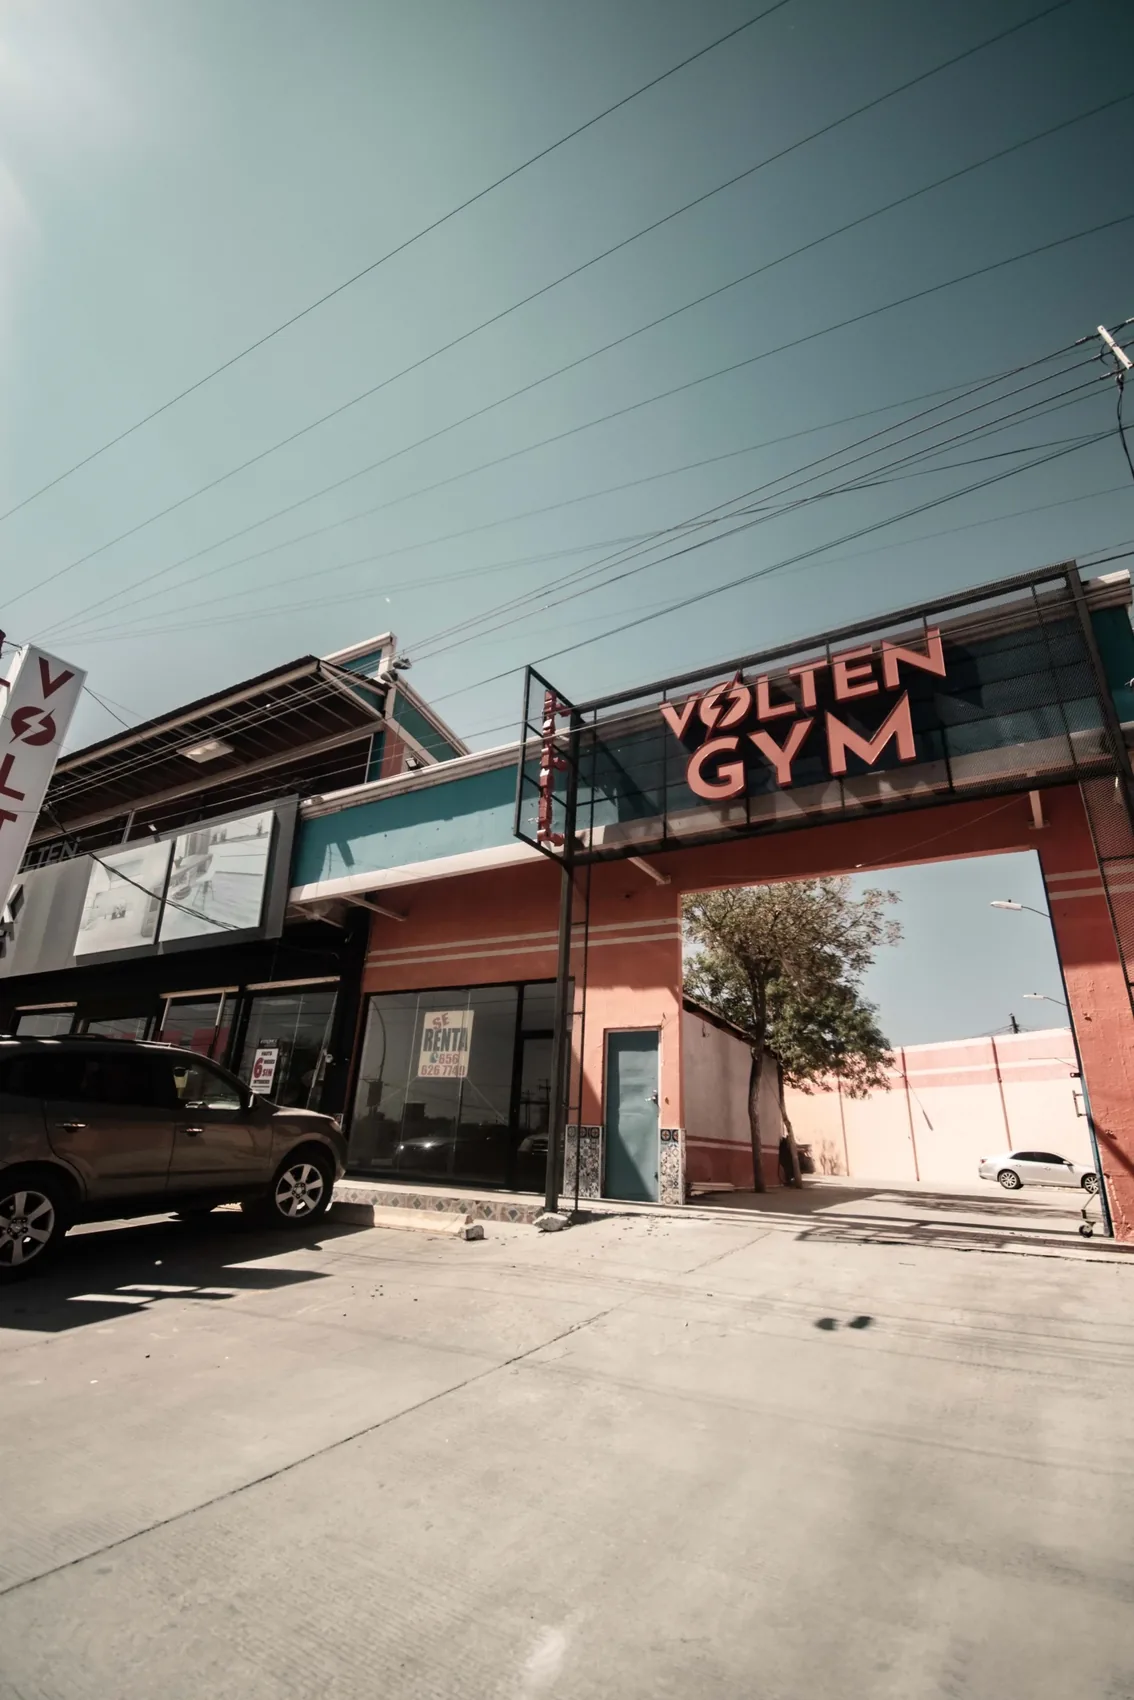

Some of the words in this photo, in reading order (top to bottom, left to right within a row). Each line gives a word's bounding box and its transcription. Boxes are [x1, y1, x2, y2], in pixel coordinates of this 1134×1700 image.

[658, 626, 947, 742] VOLTEN
[685, 690, 917, 801] GYM
[432, 1012, 450, 1030] SE
[423, 1027, 469, 1052] RENTA
[253, 1057, 264, 1079] 6
[262, 1068, 274, 1077] SIN
